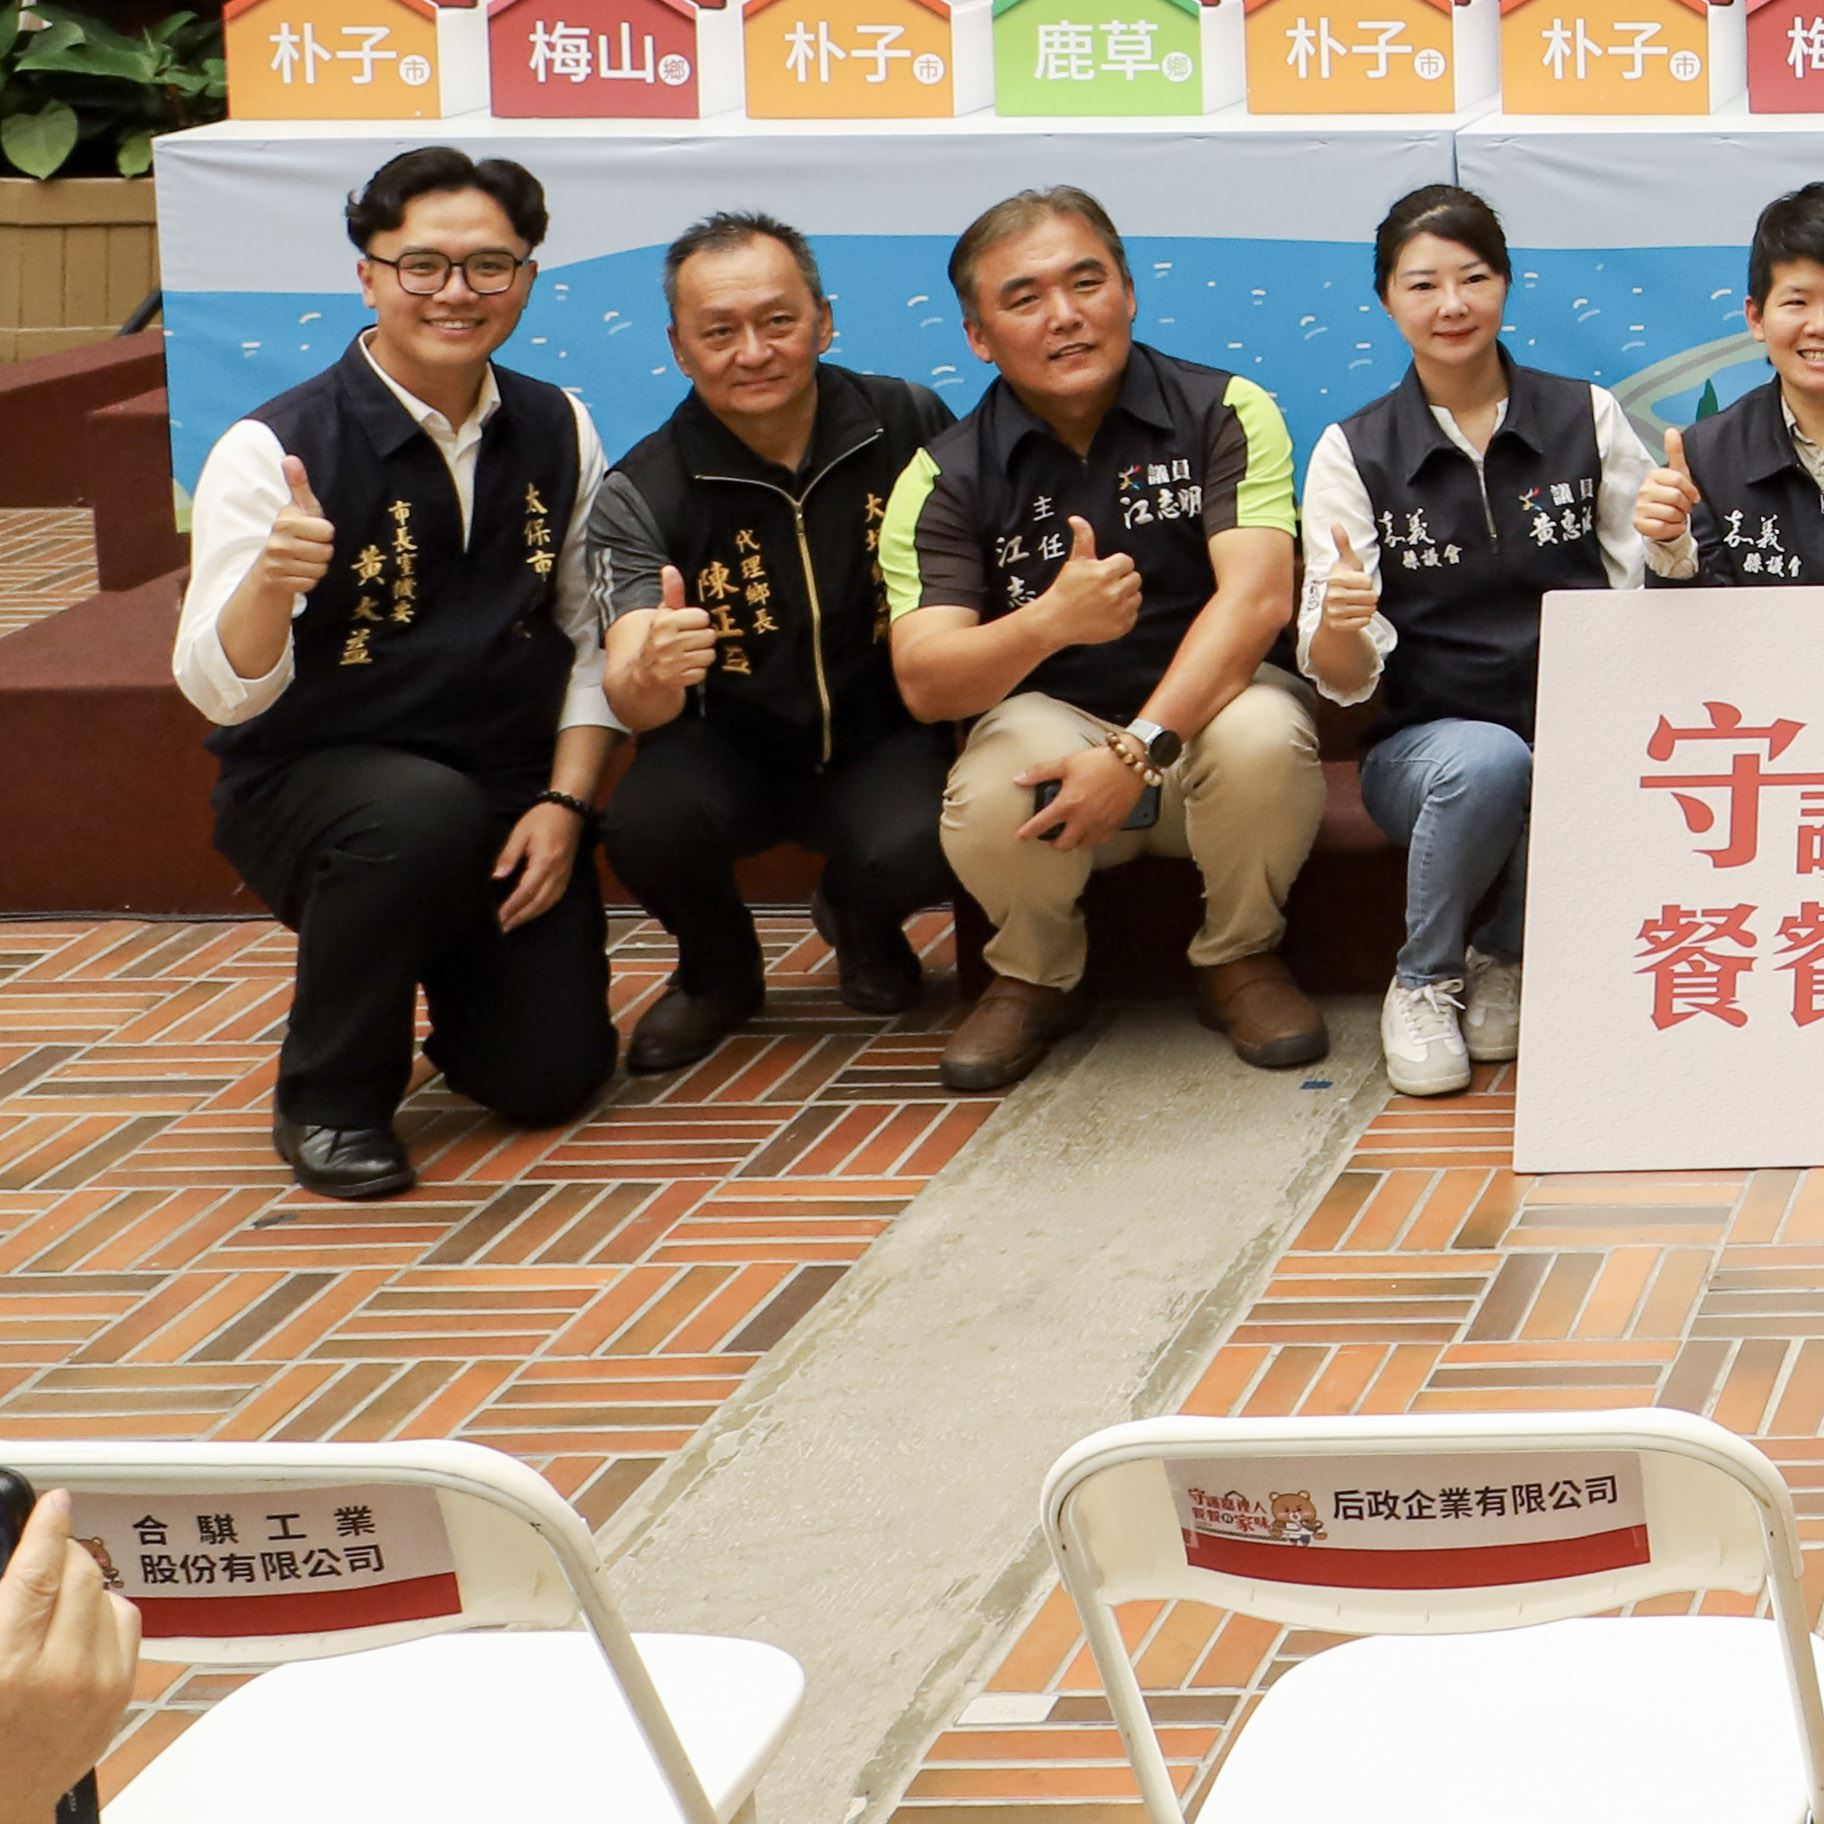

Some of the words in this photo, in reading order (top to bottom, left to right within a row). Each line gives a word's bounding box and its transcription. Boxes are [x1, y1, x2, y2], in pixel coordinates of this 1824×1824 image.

[1147, 458, 1191, 486] 議員
[1032, 495, 1066, 561] 主任
[1119, 485, 1203, 529] 江志明
[524, 482, 556, 583] 太保市
[1723, 509, 1786, 552] 嘉義
[735, 529, 780, 635] 代理鄉長
[1331, 1474, 1620, 1524] 后政企業有限公司
[133, 1505, 377, 1548] 合騏工業
[140, 1544, 386, 1588] 股份有限公司
